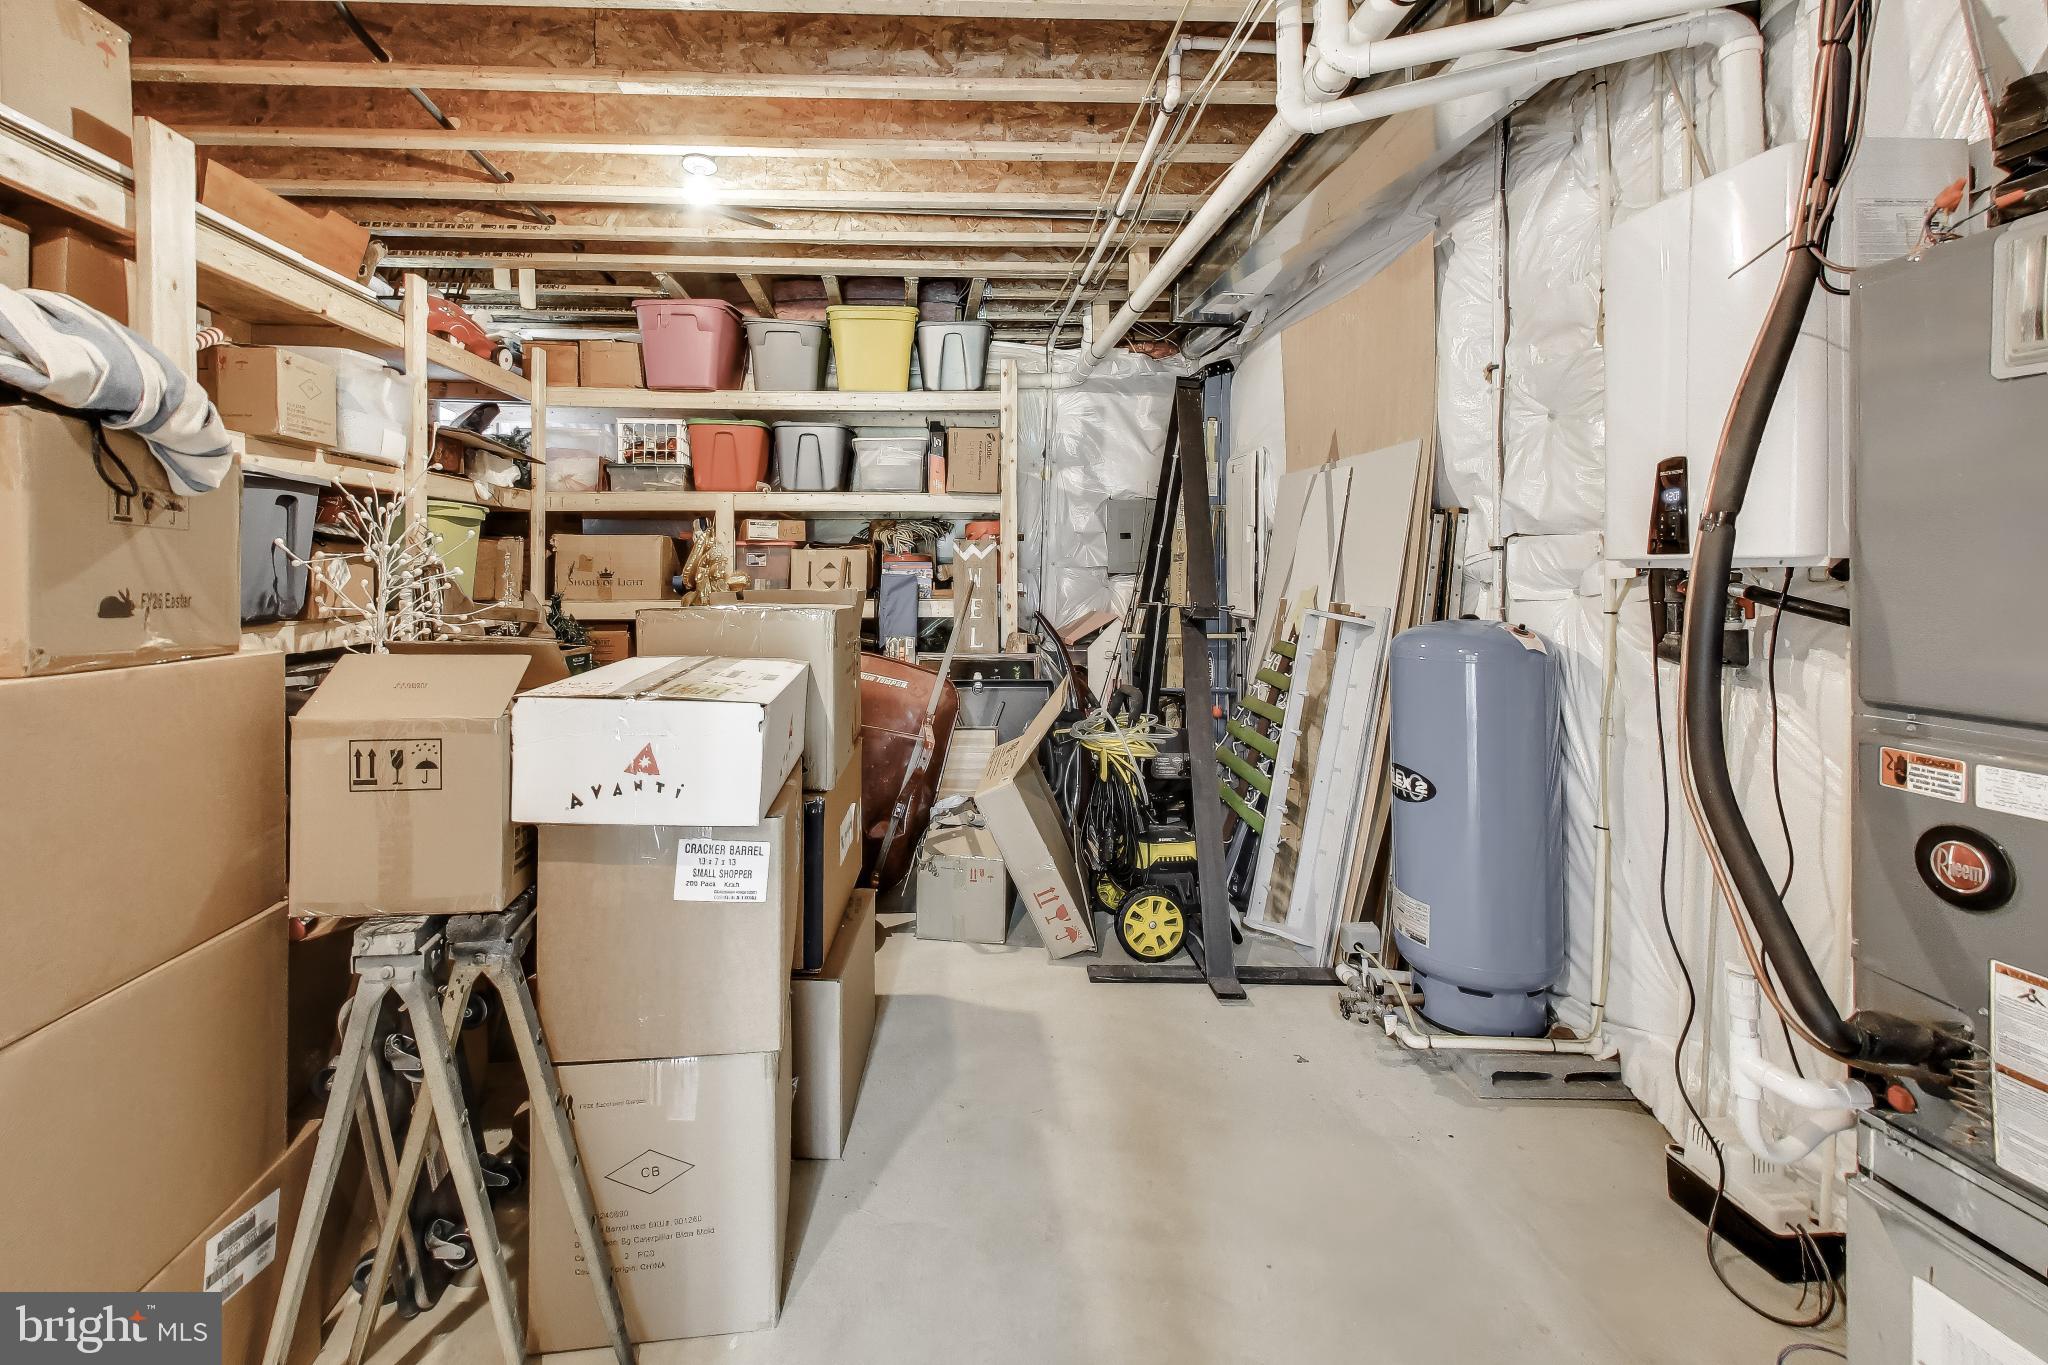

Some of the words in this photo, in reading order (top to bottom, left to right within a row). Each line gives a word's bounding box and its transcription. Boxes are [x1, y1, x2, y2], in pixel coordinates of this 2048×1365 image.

[618, 578, 644, 586] LIGHT
[165, 592, 192, 609] Easter
[684, 843, 726, 856] CRACKER
[729, 845, 764, 857] BARREL
[728, 858, 737, 866] 13
[1937, 845, 1983, 884] Rheem
[692, 868, 716, 878] SMALL
[719, 869, 753, 879] SHOPPER
[641, 1166, 660, 1178] CB
